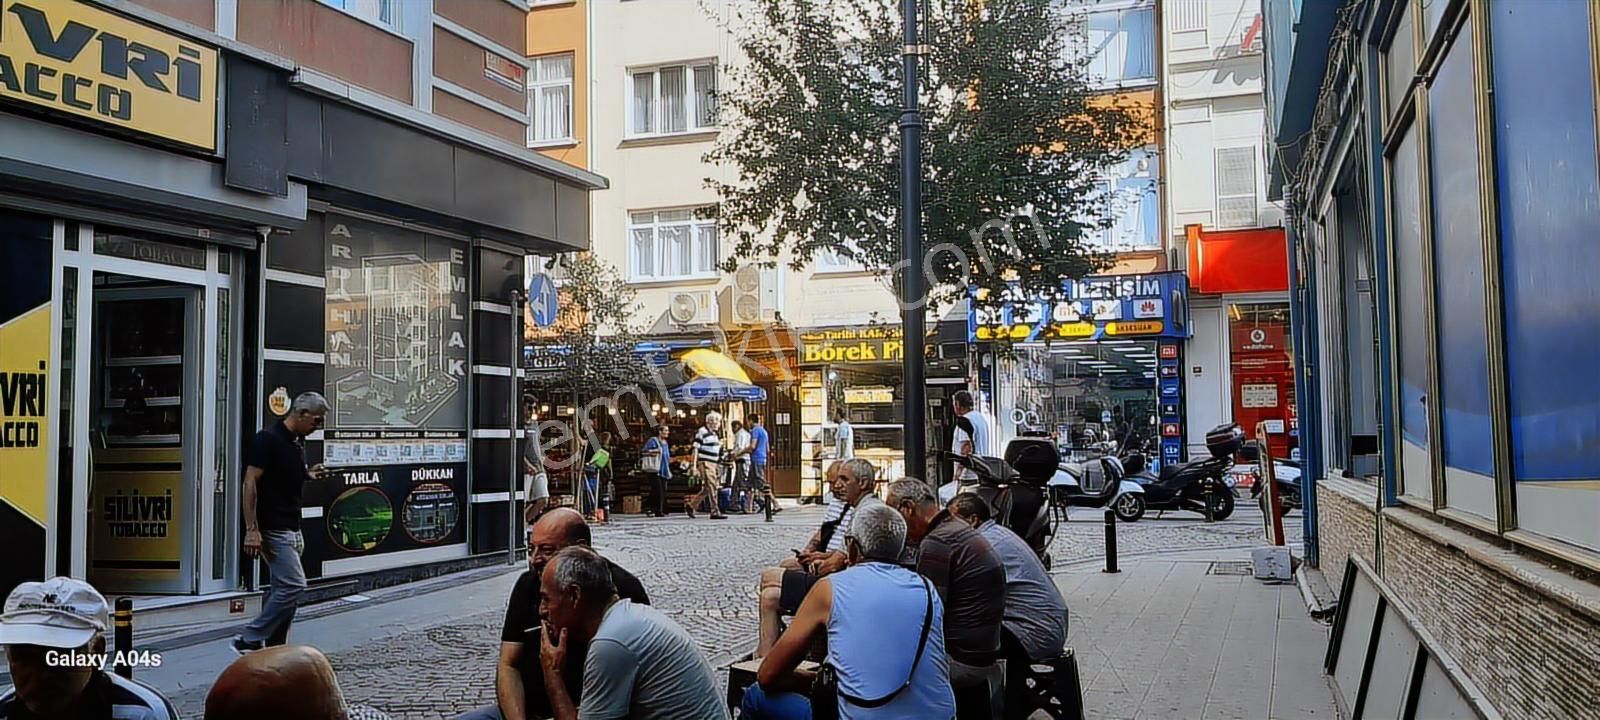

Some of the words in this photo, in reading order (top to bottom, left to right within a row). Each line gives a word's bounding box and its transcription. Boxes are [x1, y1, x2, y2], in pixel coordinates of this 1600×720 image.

[0, 0, 201, 102] VRİ
[448, 247, 466, 376] EMLAK
[805, 341, 877, 361] Börek
[343, 471, 380, 485] TARLA
[412, 467, 454, 481] DÜKKAN
